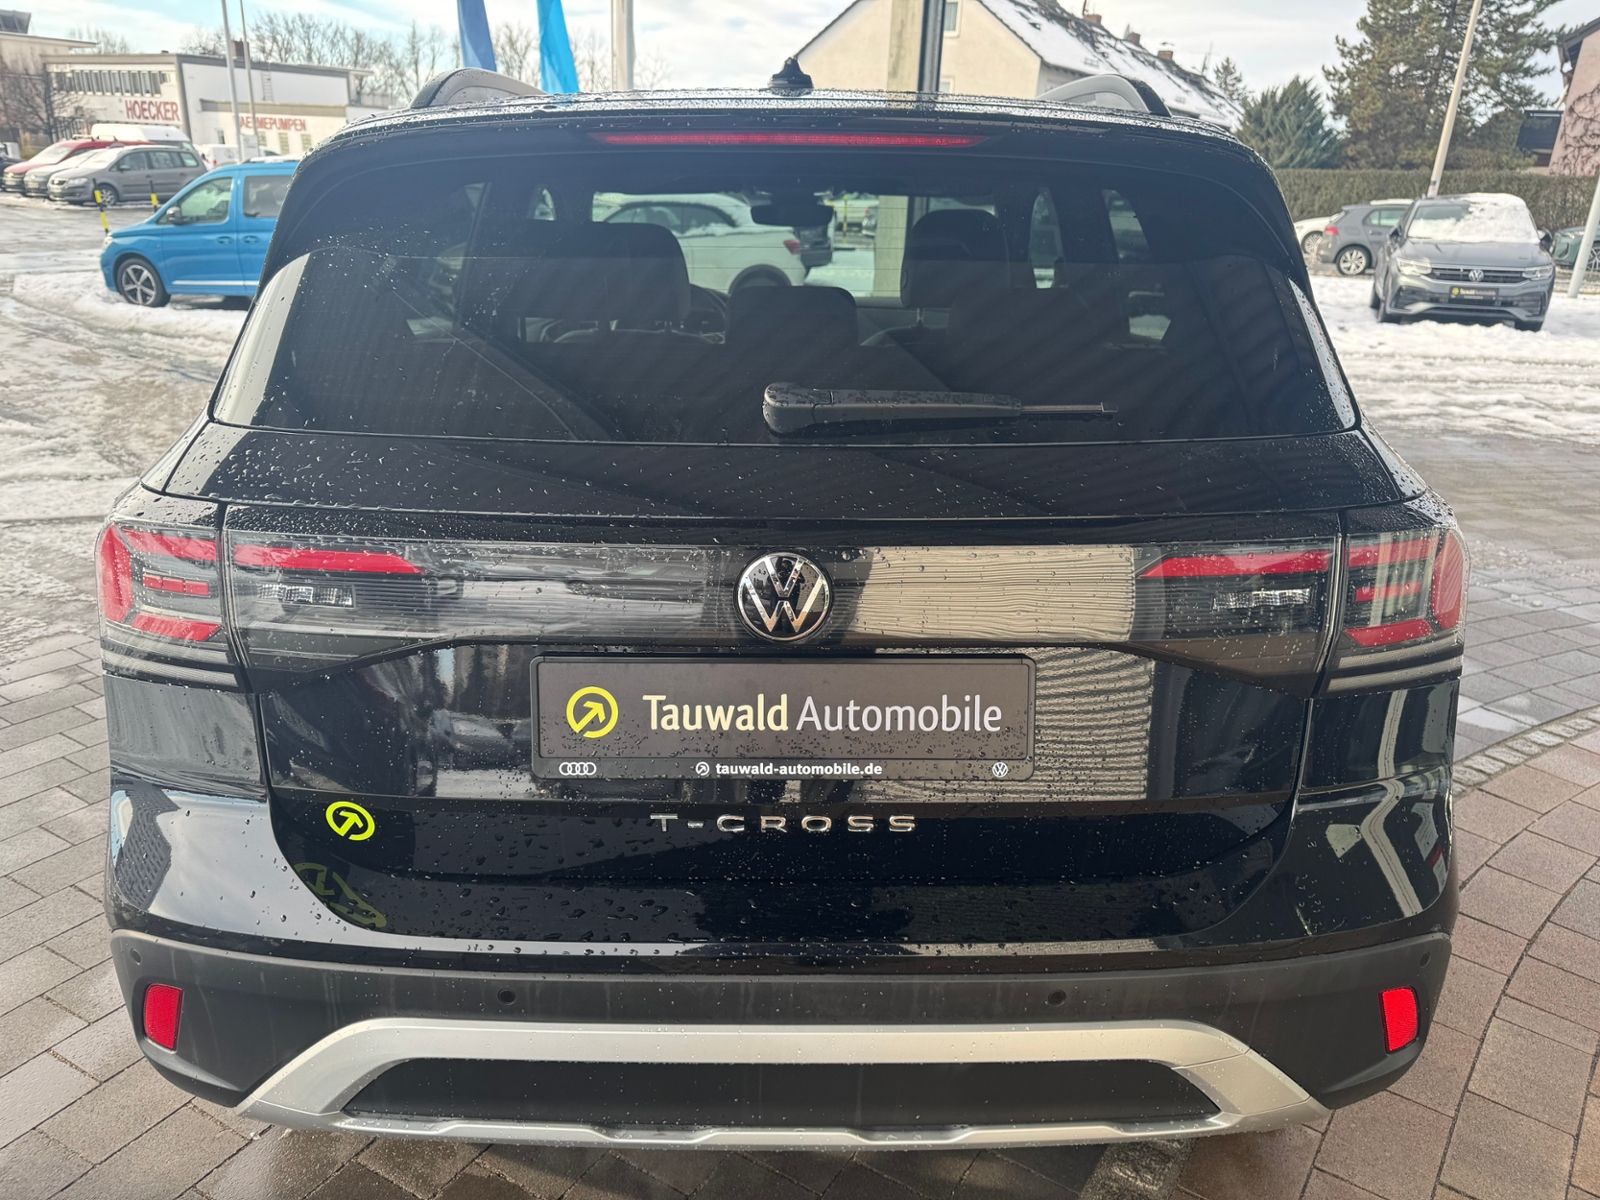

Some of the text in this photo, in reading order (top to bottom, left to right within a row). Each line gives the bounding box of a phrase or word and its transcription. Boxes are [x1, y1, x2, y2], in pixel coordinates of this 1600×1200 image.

[125, 99, 180, 121] HOECKER
[737, 551, 830, 641] VW
[642, 693, 1003, 732] Tauwald Automobile
[715, 761, 883, 776] tauwald-automobile.de
[649, 812, 917, 833] T-CROSS
